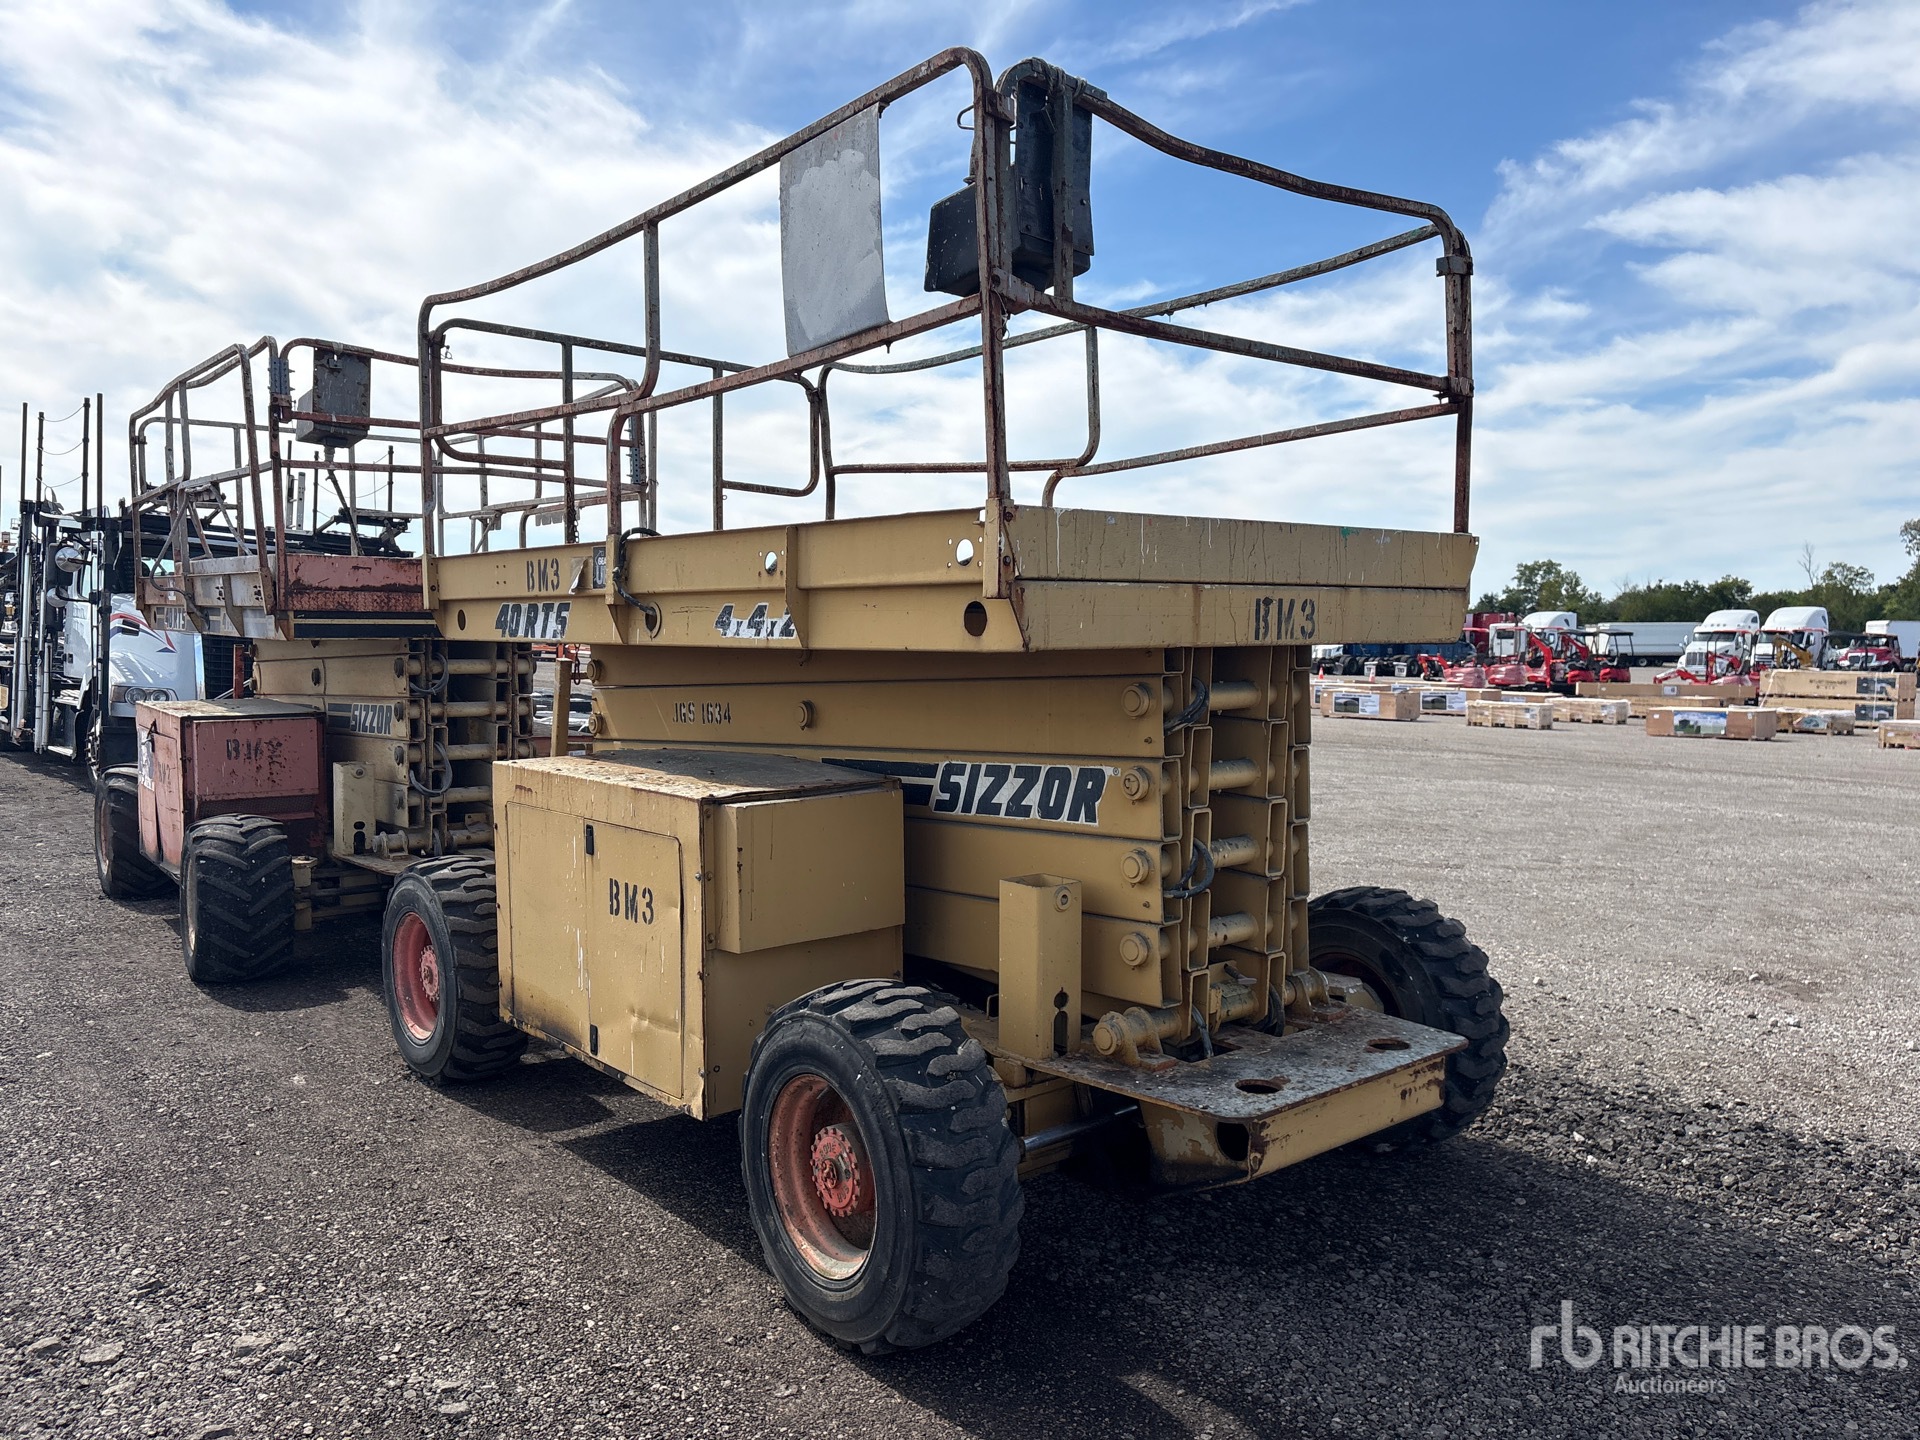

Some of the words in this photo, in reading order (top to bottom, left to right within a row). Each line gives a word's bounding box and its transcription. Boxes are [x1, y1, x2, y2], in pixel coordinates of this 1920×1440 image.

[526, 557, 560, 593] BM3
[494, 602, 571, 639] 40RTS
[1254, 597, 1316, 641] BM3
[350, 703, 393, 735] SIZZOR
[701, 701, 732, 725] 1634
[932, 762, 1107, 825] SIZZOR
[609, 877, 654, 926] BM3
